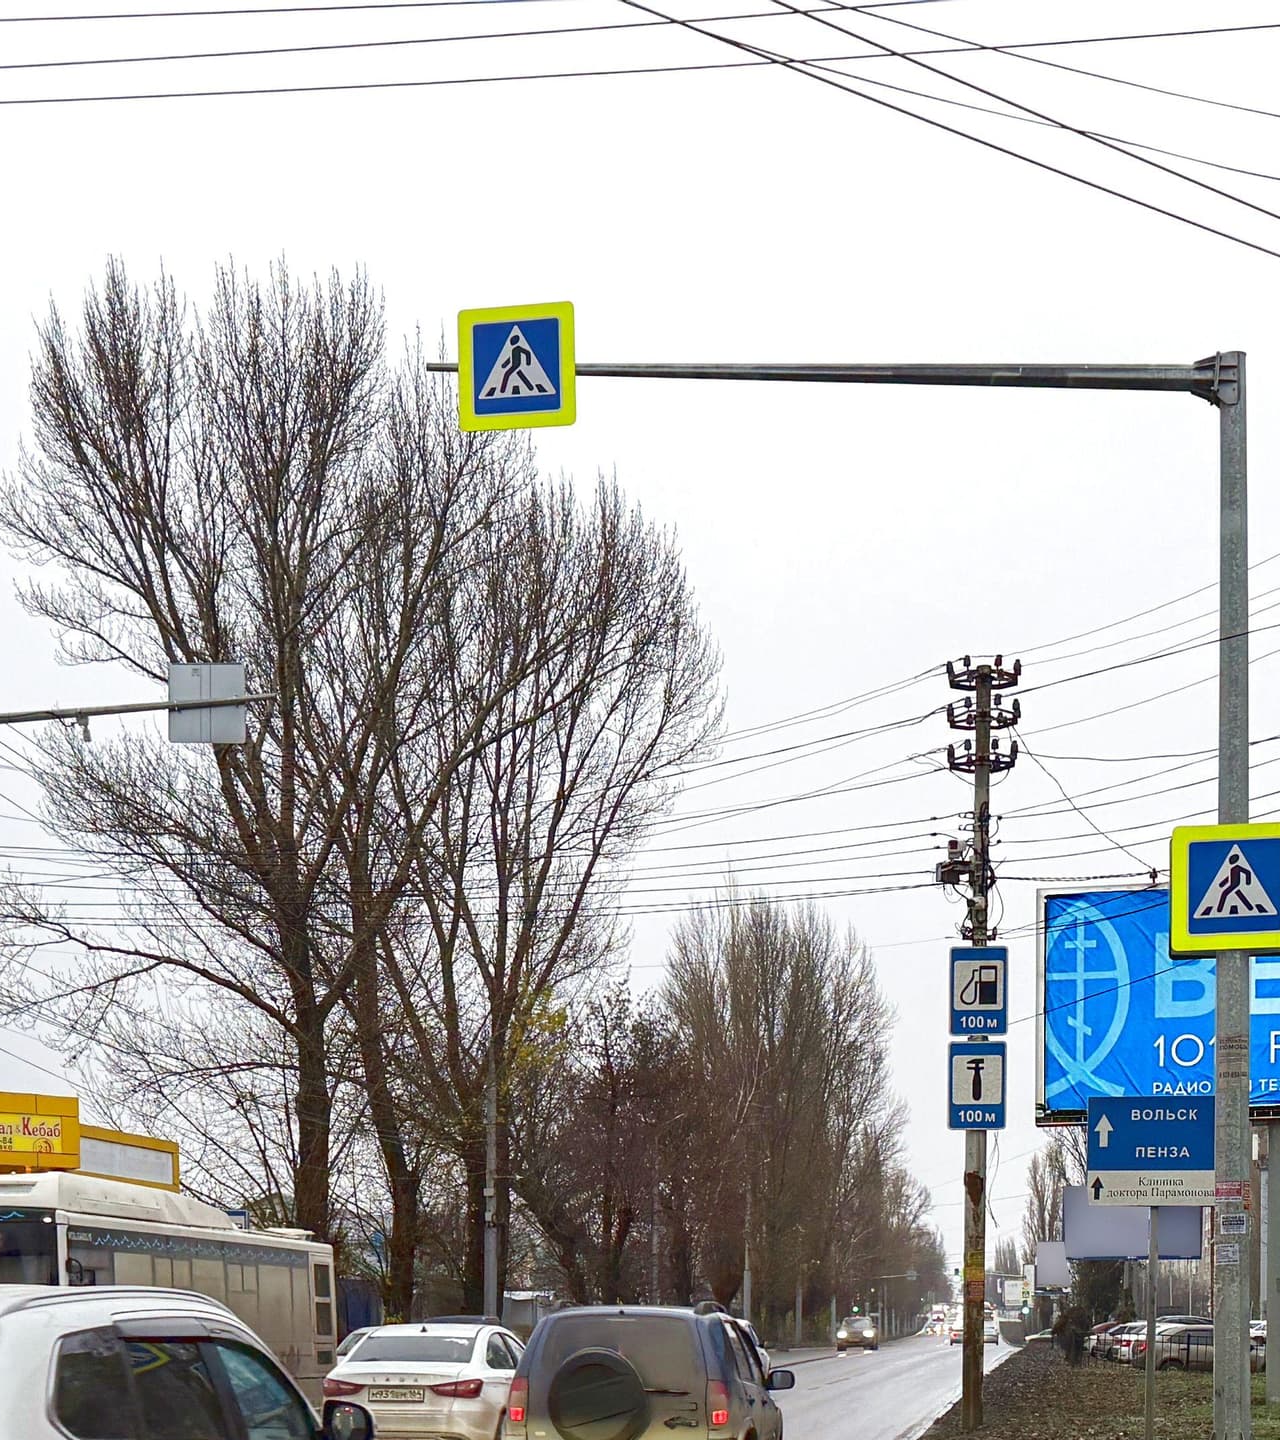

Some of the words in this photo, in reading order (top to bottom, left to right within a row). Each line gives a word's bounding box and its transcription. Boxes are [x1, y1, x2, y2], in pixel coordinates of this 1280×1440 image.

[960, 1015, 985, 1028] 100
[1153, 1081, 1211, 1095] РАДИО
[958, 1109, 983, 1123] 100
[1130, 1108, 1198, 1121] ВОЛЬСК
[22, 1116, 61, 1137] Кебаб
[1135, 1146, 1191, 1158] ПЕНЗА
[1138, 1176, 1184, 1187] Клиника
[1106, 1187, 1148, 1200] доктора
[1151, 1187, 1214, 1200] Парамонова
